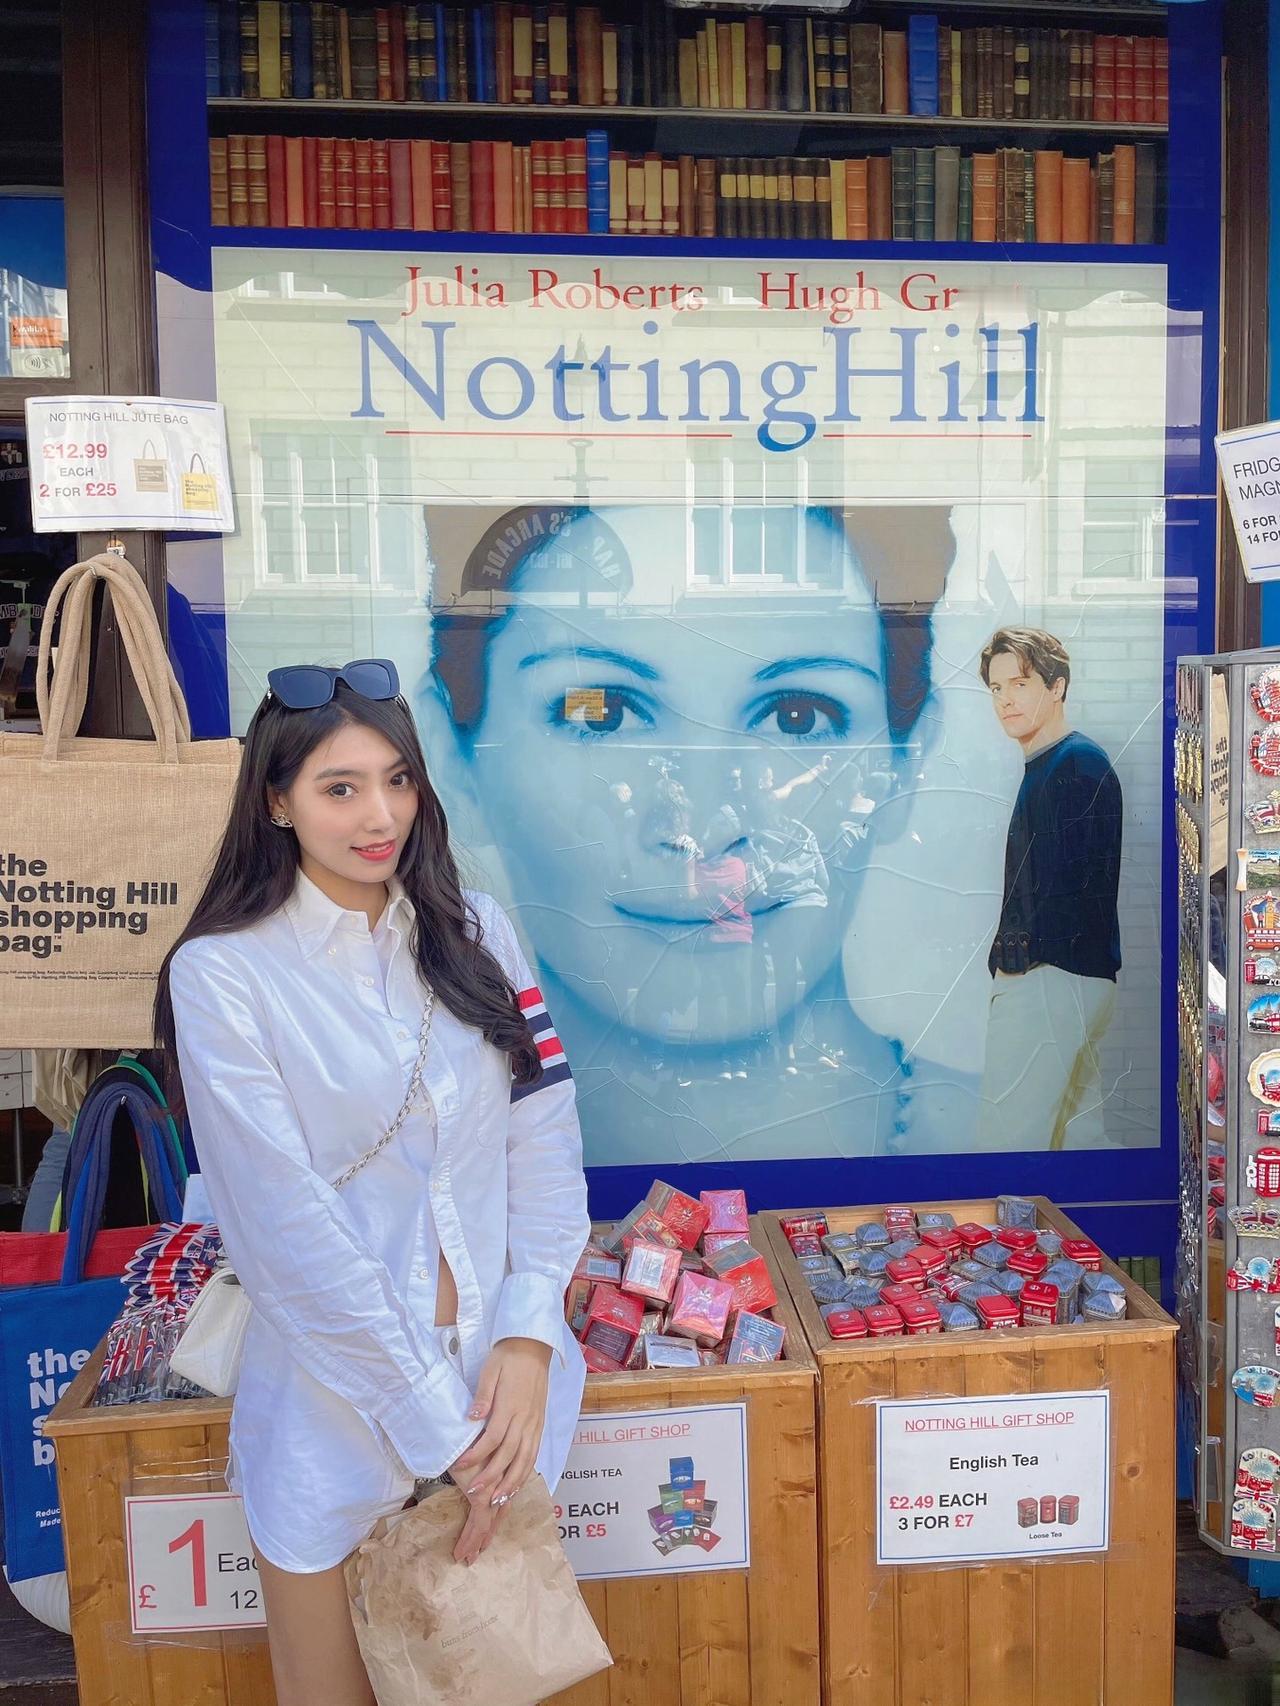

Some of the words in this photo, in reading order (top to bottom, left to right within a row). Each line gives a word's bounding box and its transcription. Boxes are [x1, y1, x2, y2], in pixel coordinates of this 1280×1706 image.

[400, 265, 509, 317] Julia
[527, 268, 704, 311] Roberts
[757, 270, 881, 324] Hugh
[49, 412, 101, 422] NOTTING
[103, 413, 129, 422] HILL
[132, 413, 161, 423] JUTE
[164, 414, 189, 425] BAG
[42, 443, 108, 459] £12.99
[59, 467, 94, 478] EACH
[1233, 456, 1280, 479] FRIDG
[39, 484, 50, 498] 2
[55, 487, 81, 498] FOR
[85, 482, 118, 498] £25
[1243, 519, 1250, 530] 6
[1252, 515, 1277, 529] FOR
[1247, 533, 1260, 545] 14
[1262, 530, 1280, 543] FO
[126, 882, 178, 905] Hill
[27, 1348, 91, 1379] the
[905, 1416, 966, 1431] NOTTING
[970, 1416, 999, 1428] HILL
[1002, 1414, 1032, 1427] GIFT
[1036, 1411, 1075, 1425] SHOP
[579, 1431, 609, 1443] HILL
[614, 1427, 647, 1440] GIFT
[650, 1423, 691, 1438] SHOP
[949, 1455, 1007, 1472] English
[1012, 1453, 1039, 1467] Tea
[601, 1468, 623, 1478] TEA
[568, 1501, 619, 1518] EACH
[889, 1495, 934, 1510] £2.49
[939, 1492, 988, 1508] EACH
[585, 1523, 607, 1538] £5
[898, 1517, 908, 1531] 3
[913, 1515, 950, 1530] FOR
[954, 1513, 974, 1528] £7
[1029, 1532, 1049, 1540] Loose
[1051, 1531, 1063, 1539] Tea
[230, 1589, 259, 1610] 12
